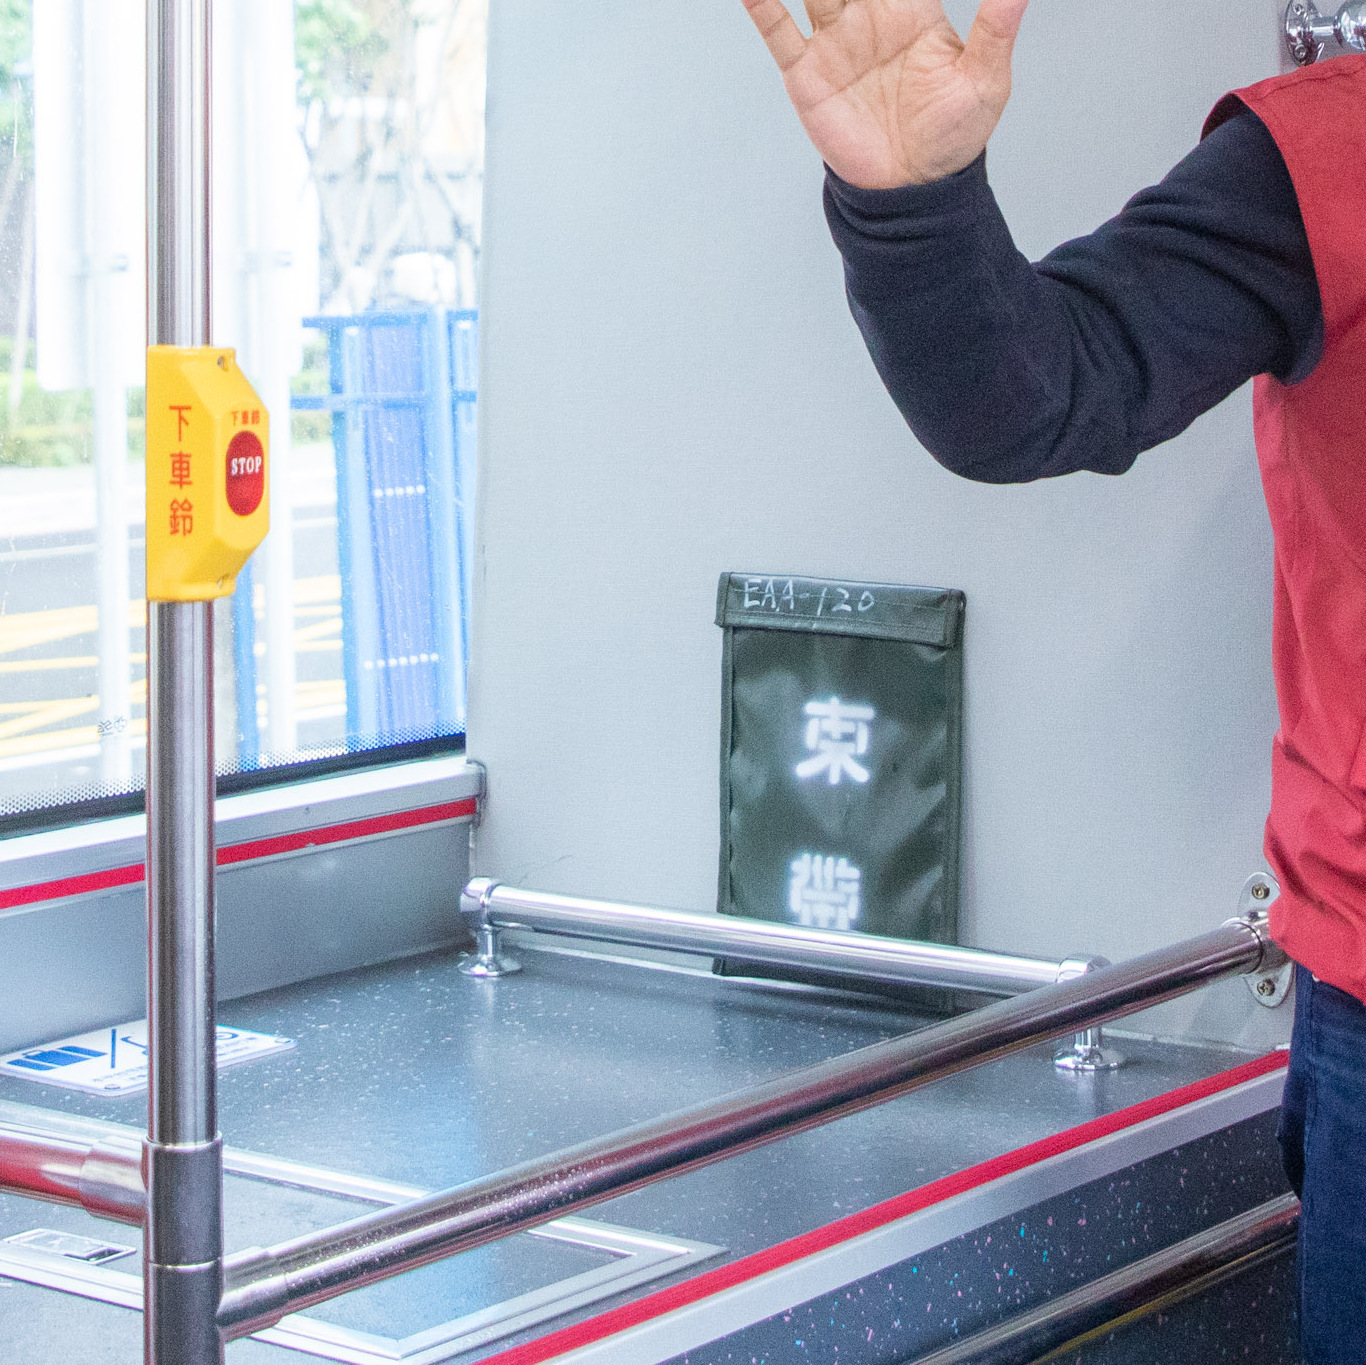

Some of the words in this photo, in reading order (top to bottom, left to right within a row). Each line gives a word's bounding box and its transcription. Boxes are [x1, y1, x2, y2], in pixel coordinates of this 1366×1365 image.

[169, 405, 193, 537] 下車鈴
[231, 455, 262, 476] STOP
[743, 578, 875, 617] EAA-120
